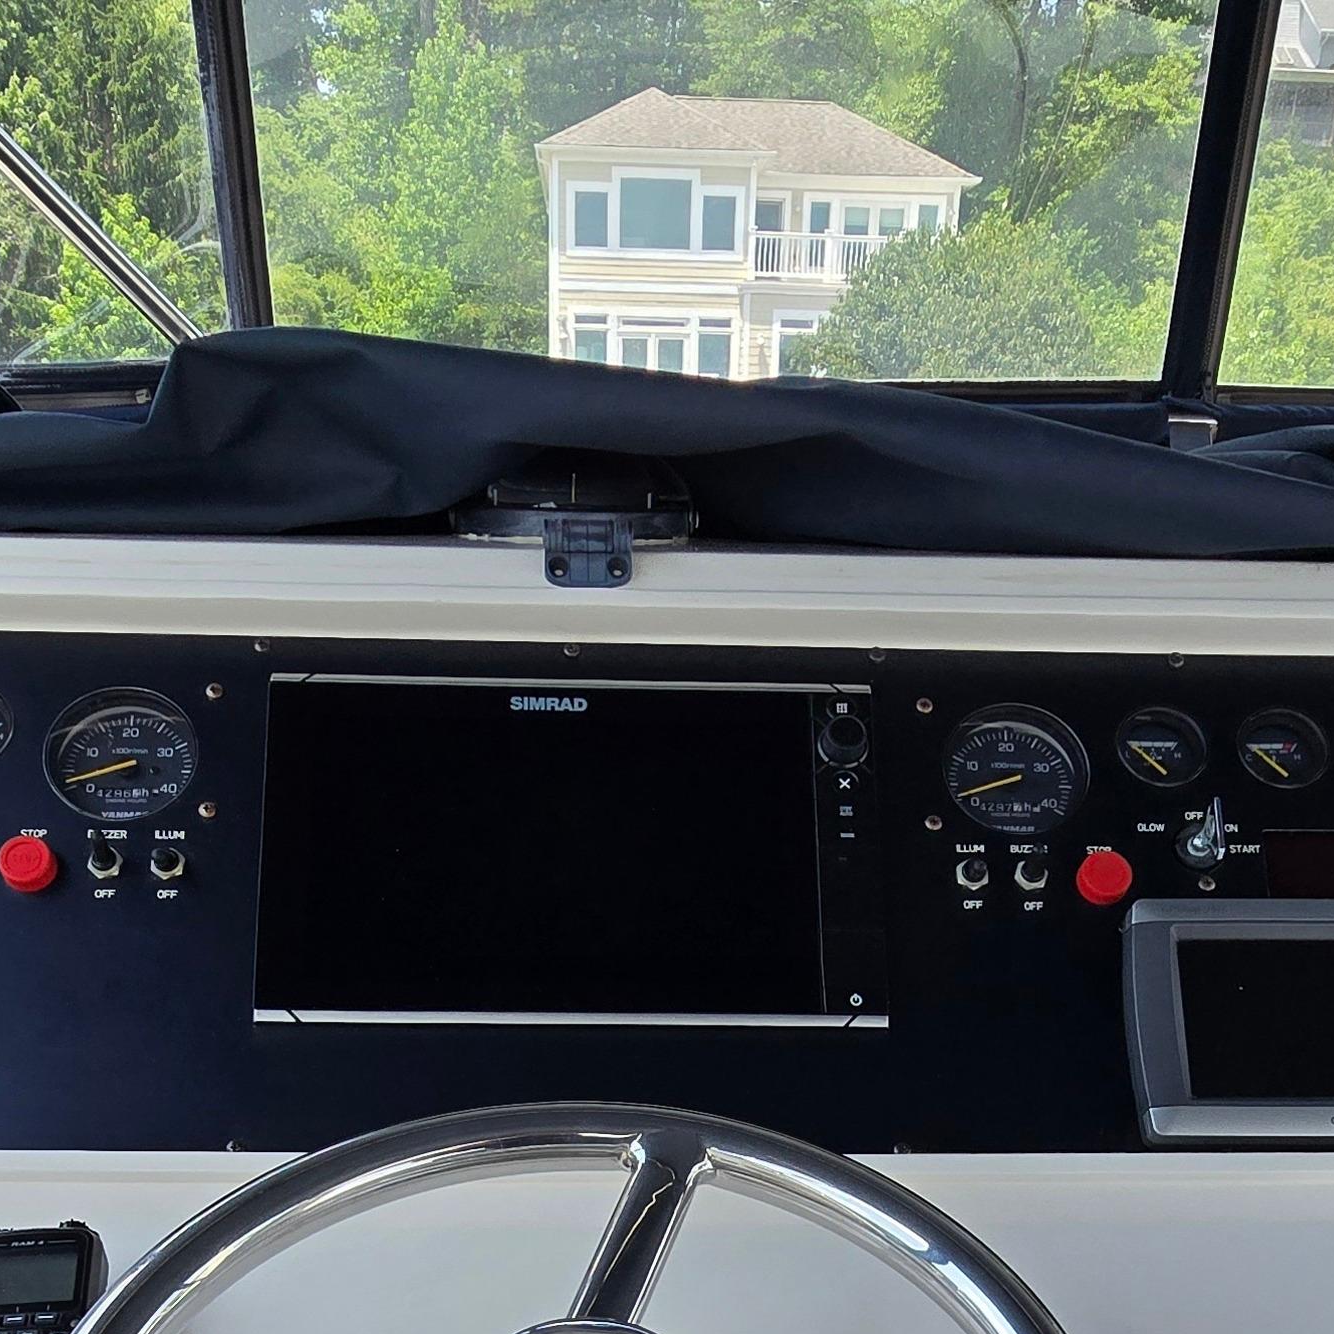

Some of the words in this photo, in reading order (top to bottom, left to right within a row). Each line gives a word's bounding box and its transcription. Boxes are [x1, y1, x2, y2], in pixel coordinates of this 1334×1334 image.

[509, 696, 588, 711] SIMRAD
[122, 727, 140, 738] 20
[86, 747, 99, 758] 10
[156, 747, 174, 758] 30
[997, 742, 1015, 753] 20
[966, 761, 979, 771] 10
[1033, 763, 1050, 773] 30
[85, 783, 95, 794] 0
[159, 783, 178, 794] 40
[970, 797, 980, 807] 0
[1041, 798, 1058, 809] 40
[1184, 811, 1204, 821] OFF
[1137, 823, 1166, 833] GLOW
[1224, 824, 1239, 833] ON
[19, 829, 48, 838] STOP
[1229, 844, 1262, 854] START
[94, 889, 117, 899] OFF
[156, 889, 179, 899] OFF
[963, 900, 983, 910] OFF
[1023, 901, 1044, 911] OFF
